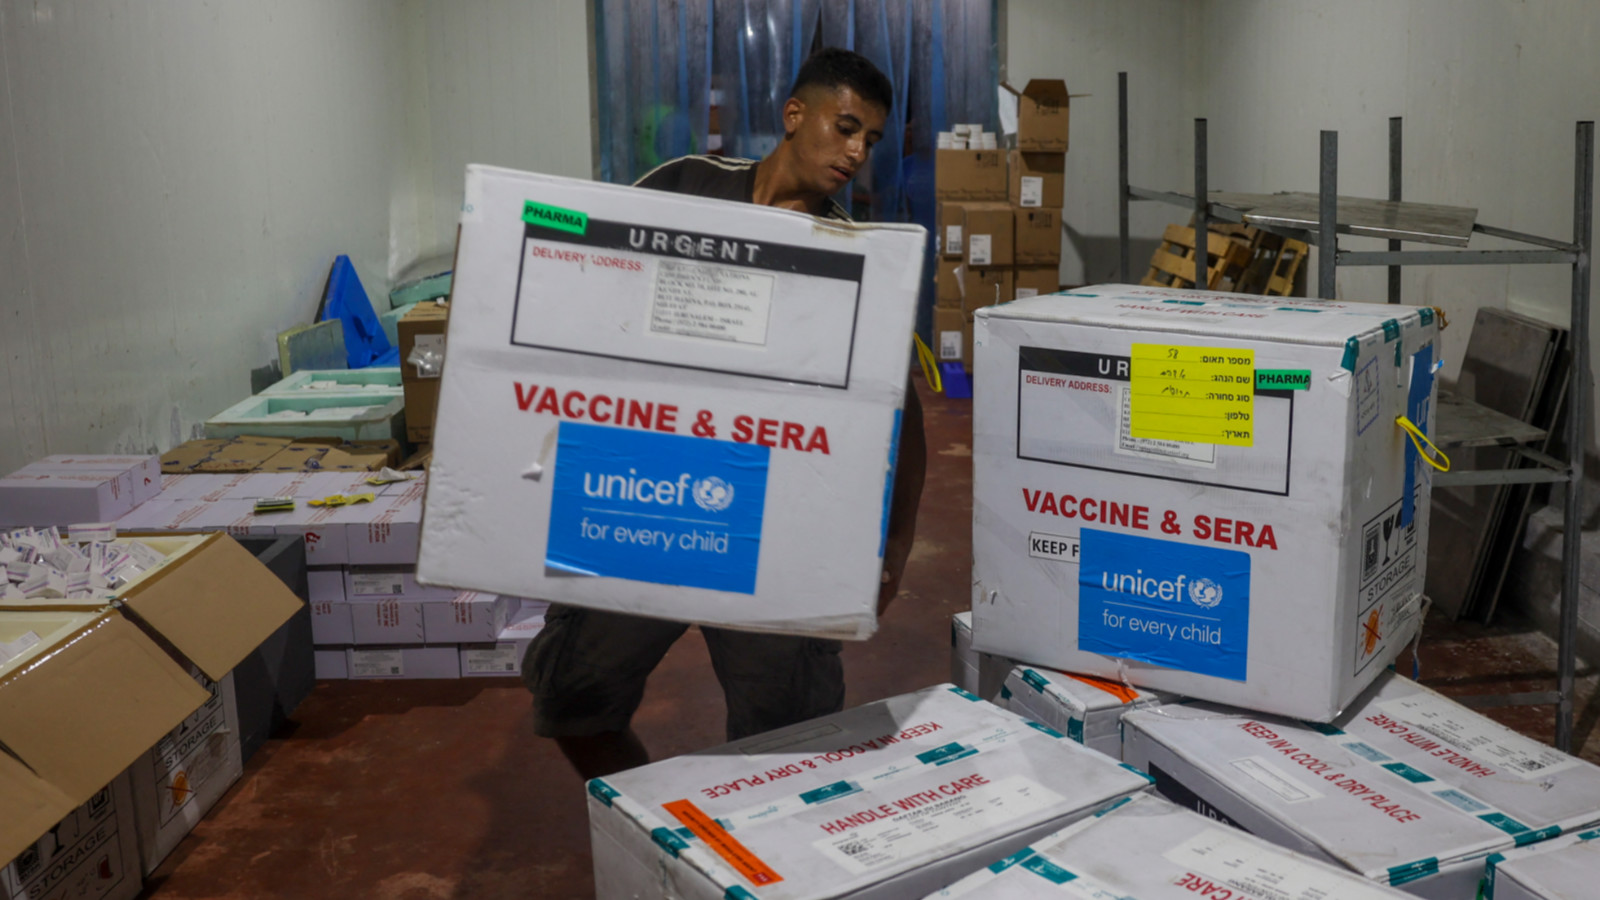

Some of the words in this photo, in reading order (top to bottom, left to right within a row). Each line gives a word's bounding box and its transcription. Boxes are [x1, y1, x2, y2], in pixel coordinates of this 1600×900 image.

[524, 205, 584, 229] PHARMA
[532, 245, 586, 263] DELIVERY
[629, 228, 760, 263] URGENT
[1227, 356, 1251, 366] מספר
[1025, 374, 1067, 389] DELIVERY
[1068, 380, 1113, 394] ADDRESS:
[1211, 374, 1234, 384] הנהג:
[1235, 376, 1251, 384] שם
[1258, 373, 1311, 387] PHARMA
[1205, 392, 1235, 402] סחורה:
[1236, 394, 1250, 403] סוג
[513, 382, 679, 433] VACCINE
[691, 410, 717, 438] &
[731, 415, 831, 455] SERA
[1224, 411, 1251, 421] טלפון:
[1221, 429, 1251, 439] תאריך:
[583, 468, 691, 506] unicef
[1022, 488, 1150, 530] VACCINE
[1160, 510, 1182, 536] &
[1193, 515, 1278, 551] SERA
[580, 517, 610, 541] for
[613, 525, 676, 552] every
[679, 531, 730, 554] child
[1032, 537, 1068, 556] KEEP
[1102, 568, 1186, 602] unicef
[1366, 553, 1412, 603] STORAGE
[1102, 608, 1124, 628] for
[1129, 618, 1178, 641] every
[1181, 622, 1222, 646] child
[900, 721, 943, 741] KEEP
[1365, 713, 1409, 734] CARE
[164, 715, 218, 769] STORAGE
[861, 738, 880, 750] A
[876, 734, 900, 747] IN
[1401, 732, 1442, 753] WITH
[799, 759, 818, 770] &
[814, 744, 866, 765] COOL
[1431, 748, 1497, 778] HANDLE
[768, 764, 803, 782] DRY
[1237, 721, 1279, 741] KEEP
[1265, 738, 1288, 749] IN
[1278, 747, 1300, 757] A
[1290, 752, 1334, 776] COOL
[1323, 773, 1345, 782] &
[1334, 779, 1376, 797] DRY
[1361, 795, 1422, 823] PLACE
[701, 774, 766, 800] PLACE
[819, 803, 900, 836] HANDLE
[891, 789, 938, 812] WITH
[937, 773, 991, 795] CARE
[28, 827, 107, 900] STORAGE
[1174, 872, 1233, 900] CARE
